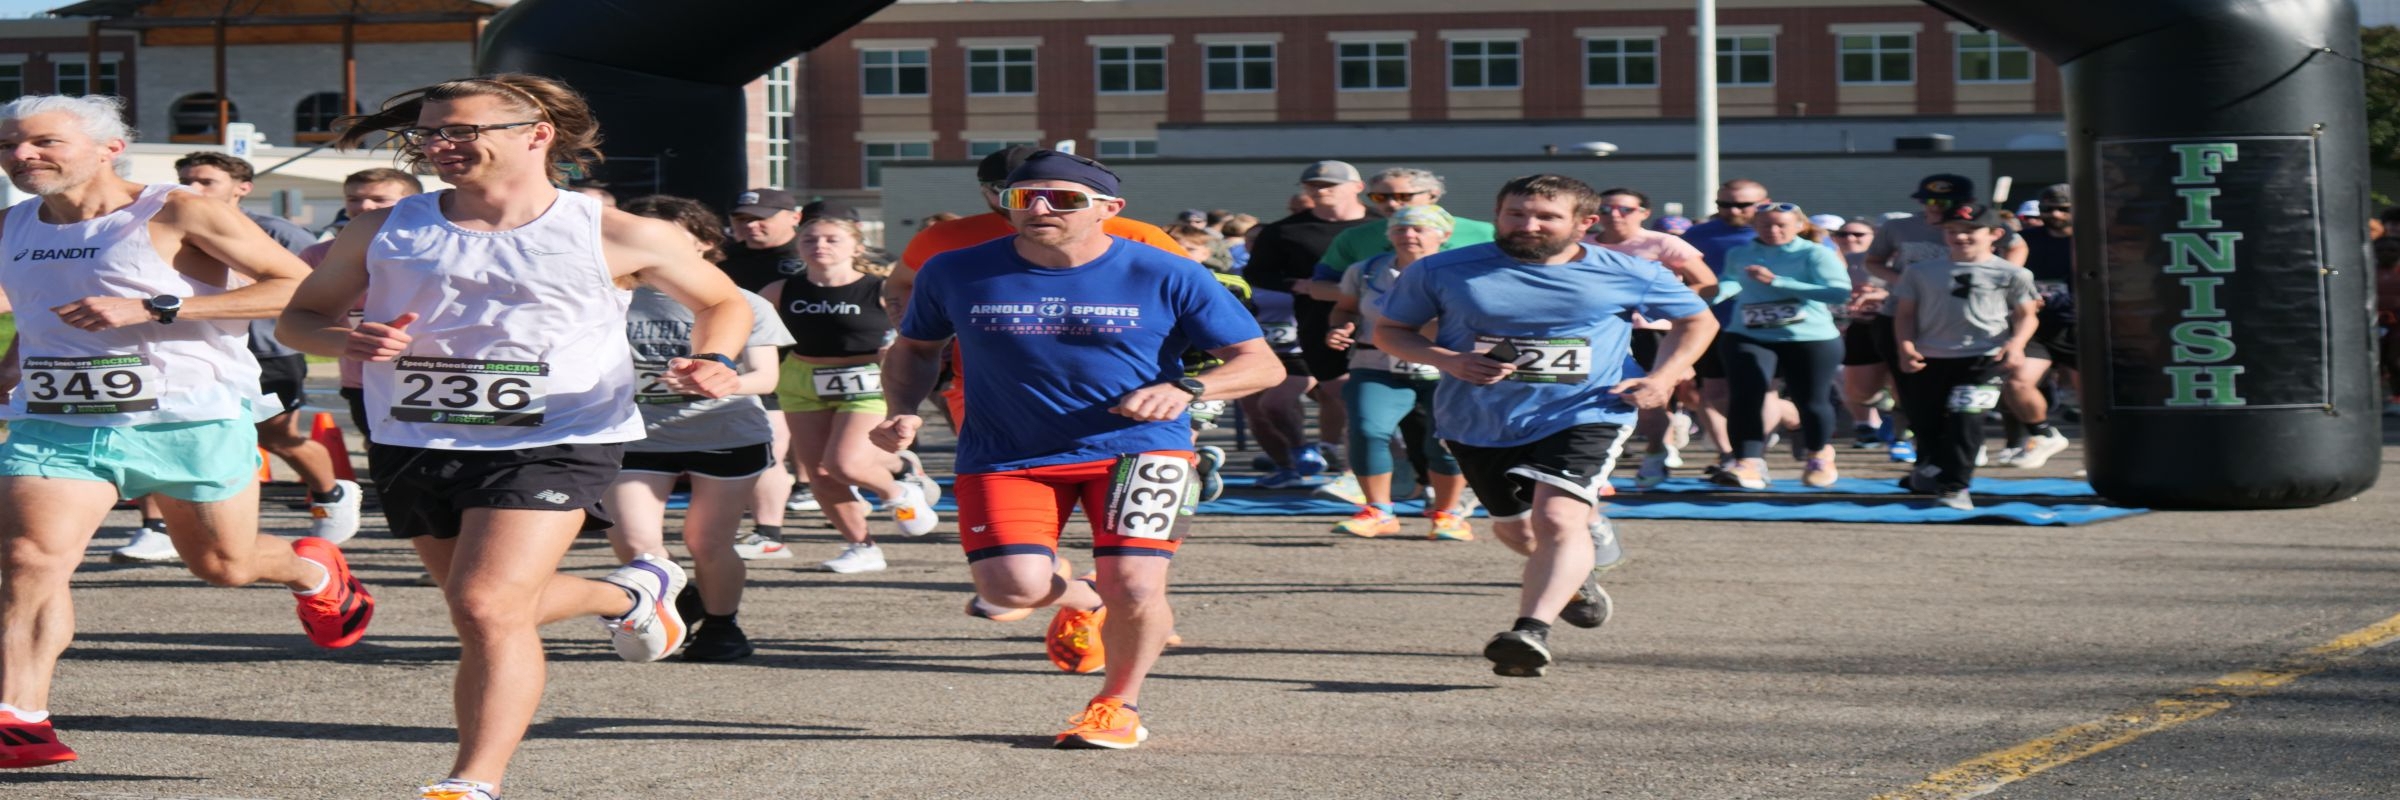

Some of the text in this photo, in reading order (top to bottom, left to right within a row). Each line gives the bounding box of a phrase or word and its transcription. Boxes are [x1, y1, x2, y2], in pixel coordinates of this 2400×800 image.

[31, 247, 100, 261] BANDIT
[2161, 142, 2247, 407] FINISH
[789, 299, 861, 315] Calvin
[970, 304, 1140, 317] ARNOLD SPORTS
[402, 360, 540, 372] Speedy Sneakers RACING
[30, 369, 143, 401] 349
[401, 373, 532, 411] 236
[1123, 462, 1184, 533] 336
